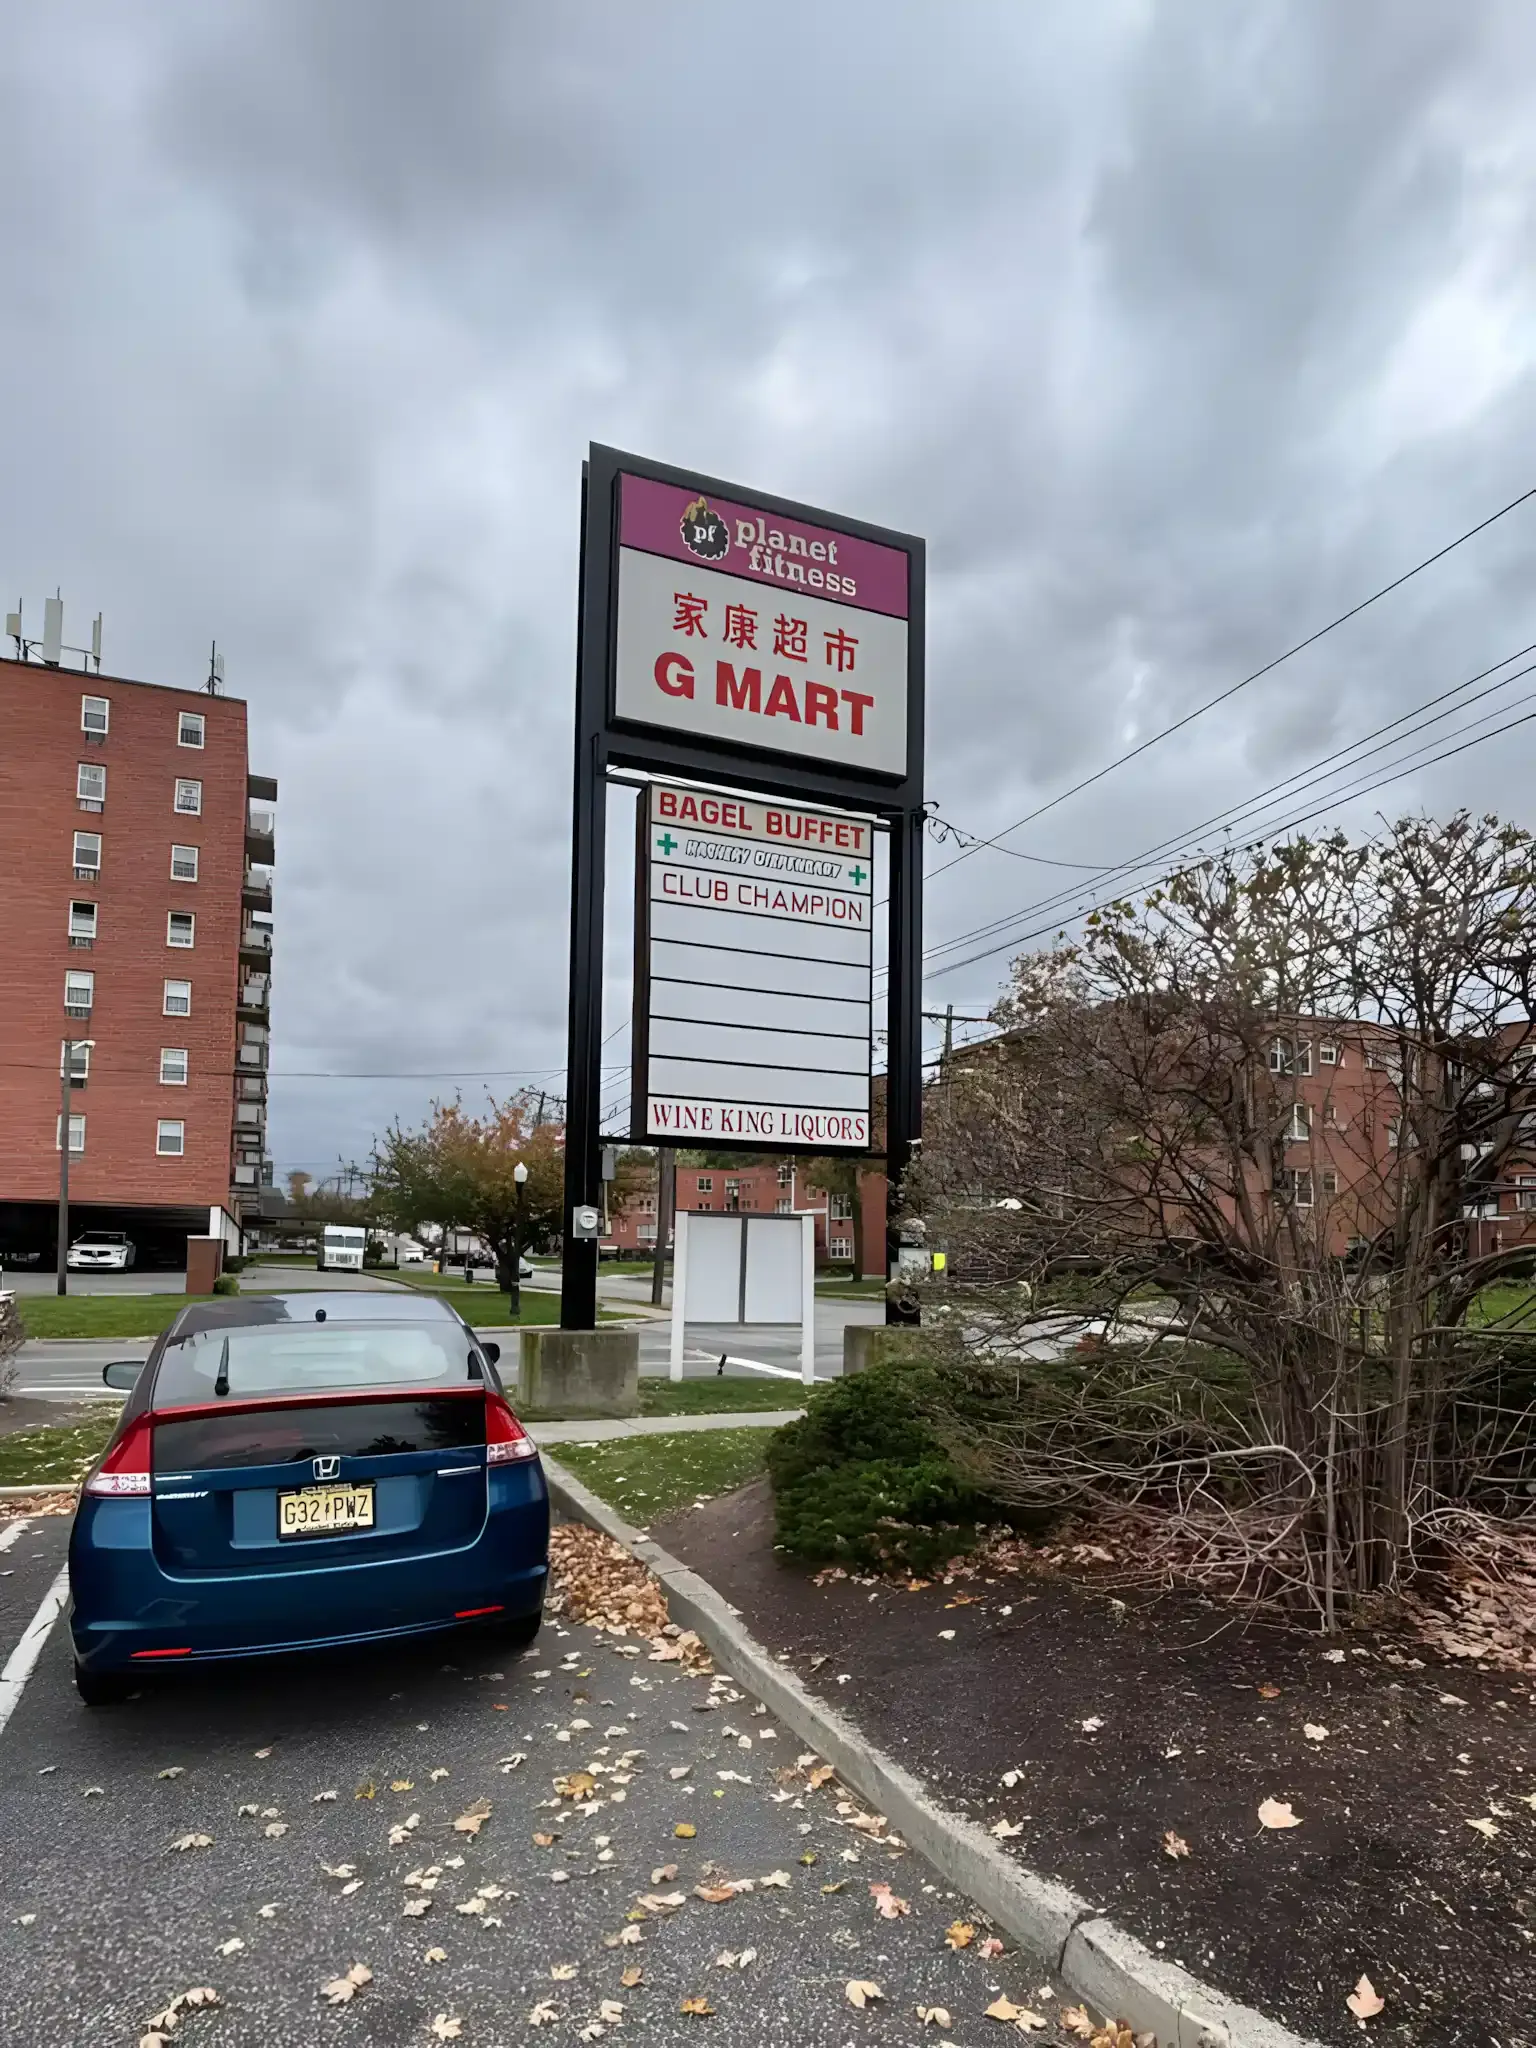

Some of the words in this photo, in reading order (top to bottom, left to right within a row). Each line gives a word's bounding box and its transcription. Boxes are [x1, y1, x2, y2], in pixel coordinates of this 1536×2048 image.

[693, 524, 717, 544] pf
[734, 517, 838, 565] planet
[748, 545, 857, 597] fitness
[672, 591, 859, 672] 家康超市
[654, 651, 695, 701] G
[715, 659, 874, 736] MART
[659, 791, 752, 831] BAGEL
[766, 811, 865, 849] BUFFET
[662, 872, 729, 902] CLUB
[737, 884, 863, 922] CHAMPION
[653, 1104, 712, 1131] WINE
[720, 1109, 773, 1134] KING
[781, 1113, 865, 1141] LIQUORS
